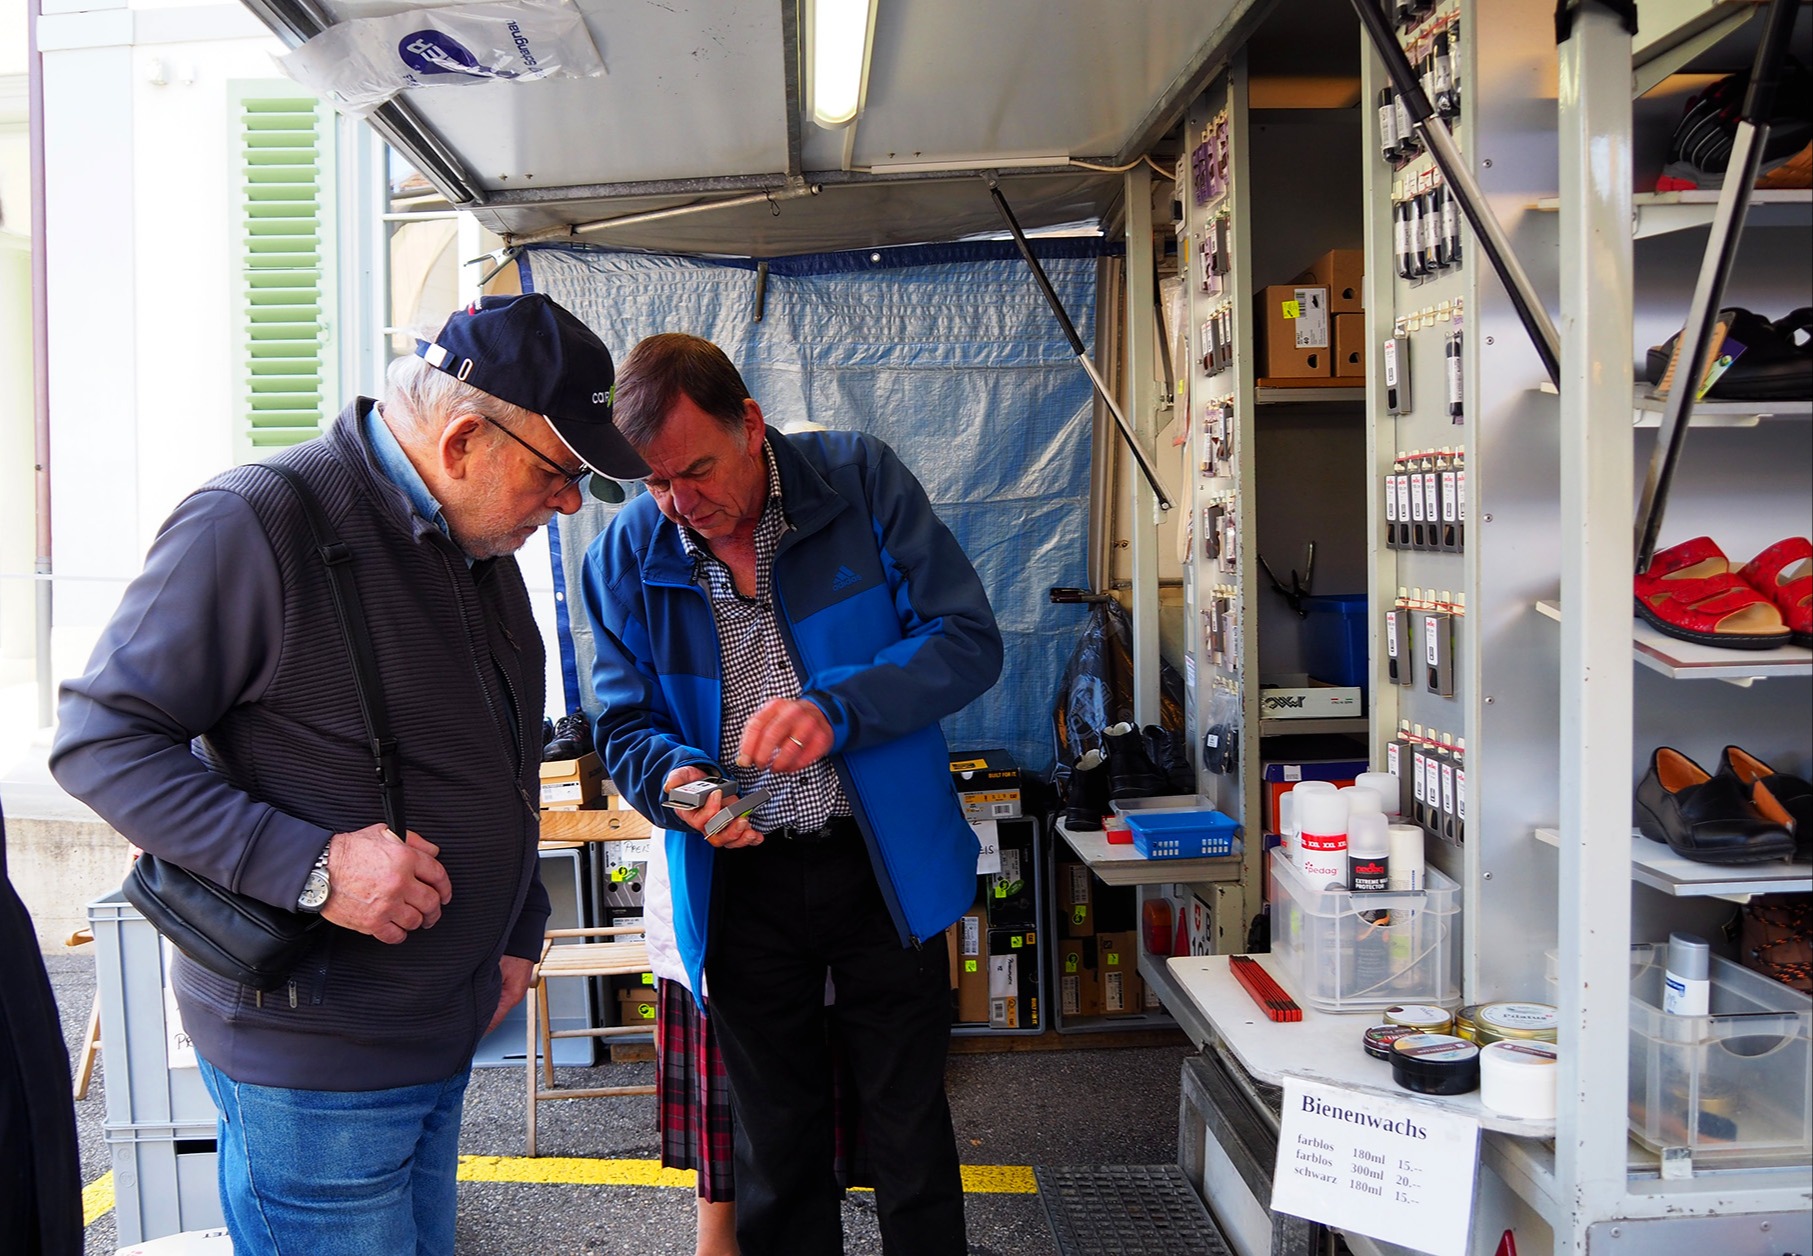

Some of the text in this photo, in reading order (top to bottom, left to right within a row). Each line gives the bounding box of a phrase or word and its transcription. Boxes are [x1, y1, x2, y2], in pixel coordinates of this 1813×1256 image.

[1308, 867, 1338, 876] pedag
[1301, 1094, 1427, 1140] Bienenwachs
[1295, 1149, 1421, 1189] farblos 300ml 20.--
[1297, 1134, 1423, 1173] farblos 180ml 15.--
[1294, 1166, 1420, 1205] schwarz 180ml 15.--
